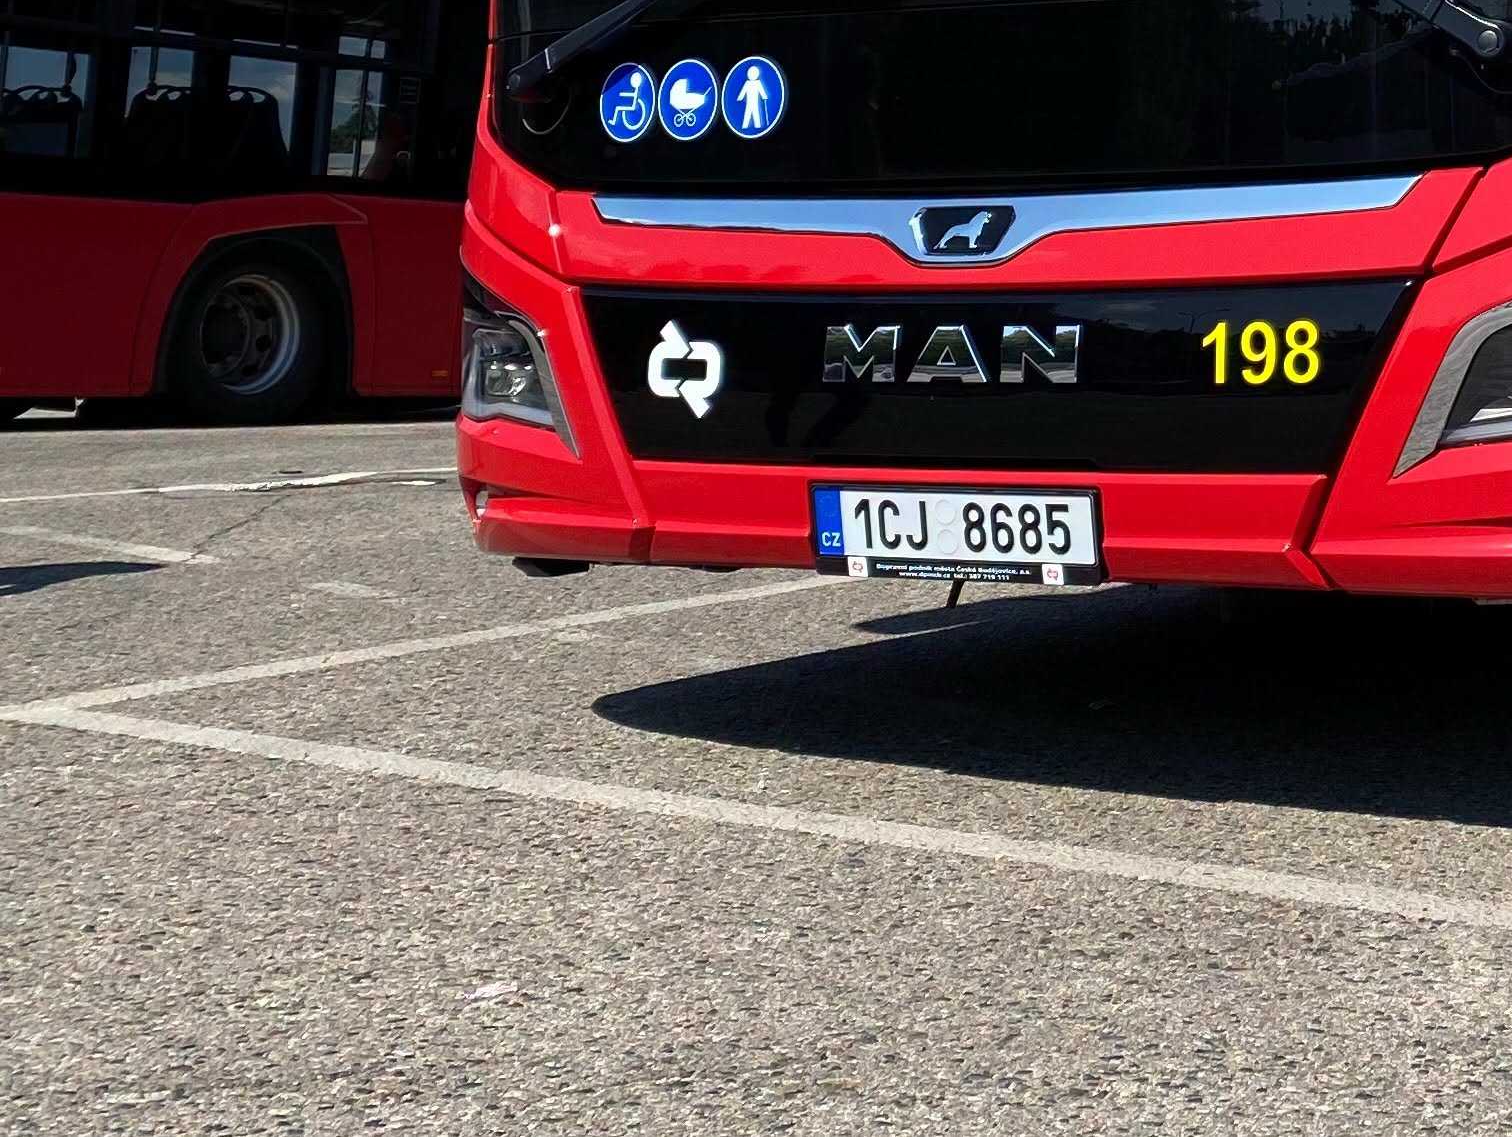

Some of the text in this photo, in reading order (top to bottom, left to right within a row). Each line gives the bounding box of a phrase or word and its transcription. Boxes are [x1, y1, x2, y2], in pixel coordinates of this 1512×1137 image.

[821, 323, 1082, 384] MAN
[1201, 318, 1320, 385] 198
[821, 531, 841, 547] CZ
[854, 497, 1072, 555] 1CJ 8685
